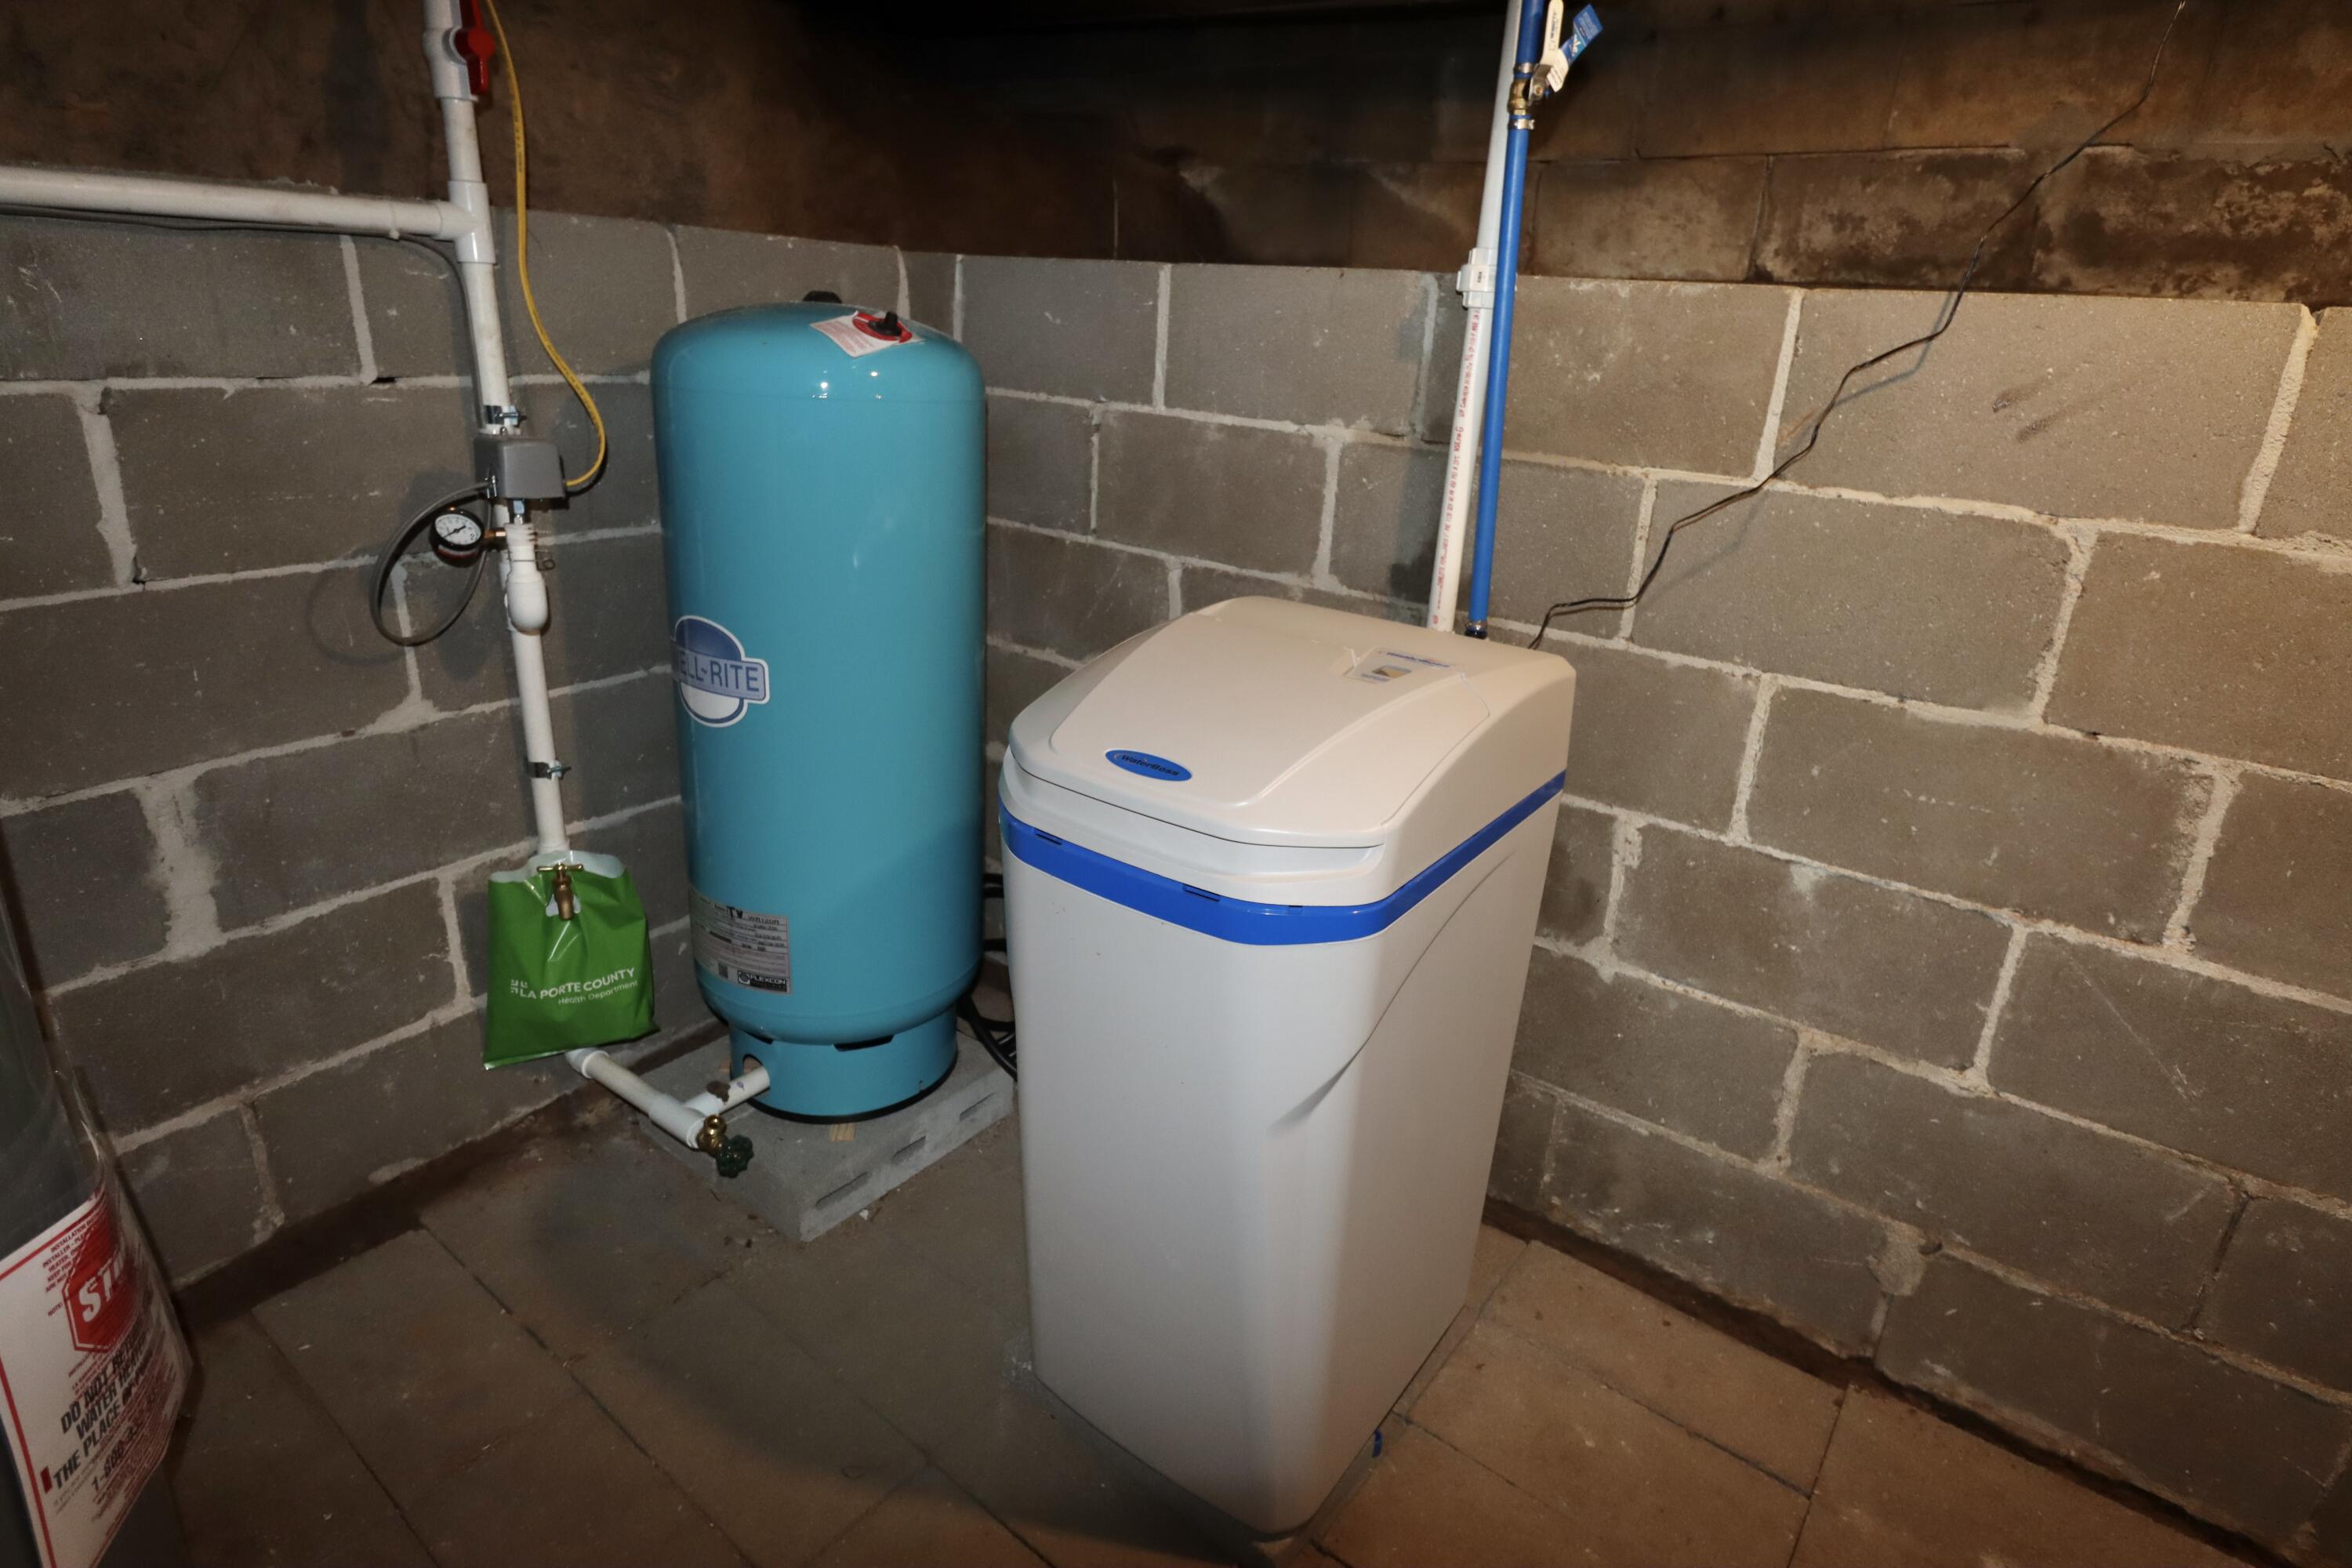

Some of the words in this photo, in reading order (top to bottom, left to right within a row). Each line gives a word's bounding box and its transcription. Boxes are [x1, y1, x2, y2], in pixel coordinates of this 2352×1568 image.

[676, 649, 760, 693] ELL-RITE
[520, 989, 537, 1000] LA
[539, 982, 582, 1000] PORTE
[583, 967, 635, 993] COUNTY
[557, 995, 587, 1005] Health
[588, 980, 638, 1000] Department
[60, 1400, 82, 1436] DO
[83, 1367, 108, 1410] NOT
[76, 1382, 118, 1441] WATER
[53, 1449, 82, 1490] THE
[83, 1403, 121, 1457] PLACE
